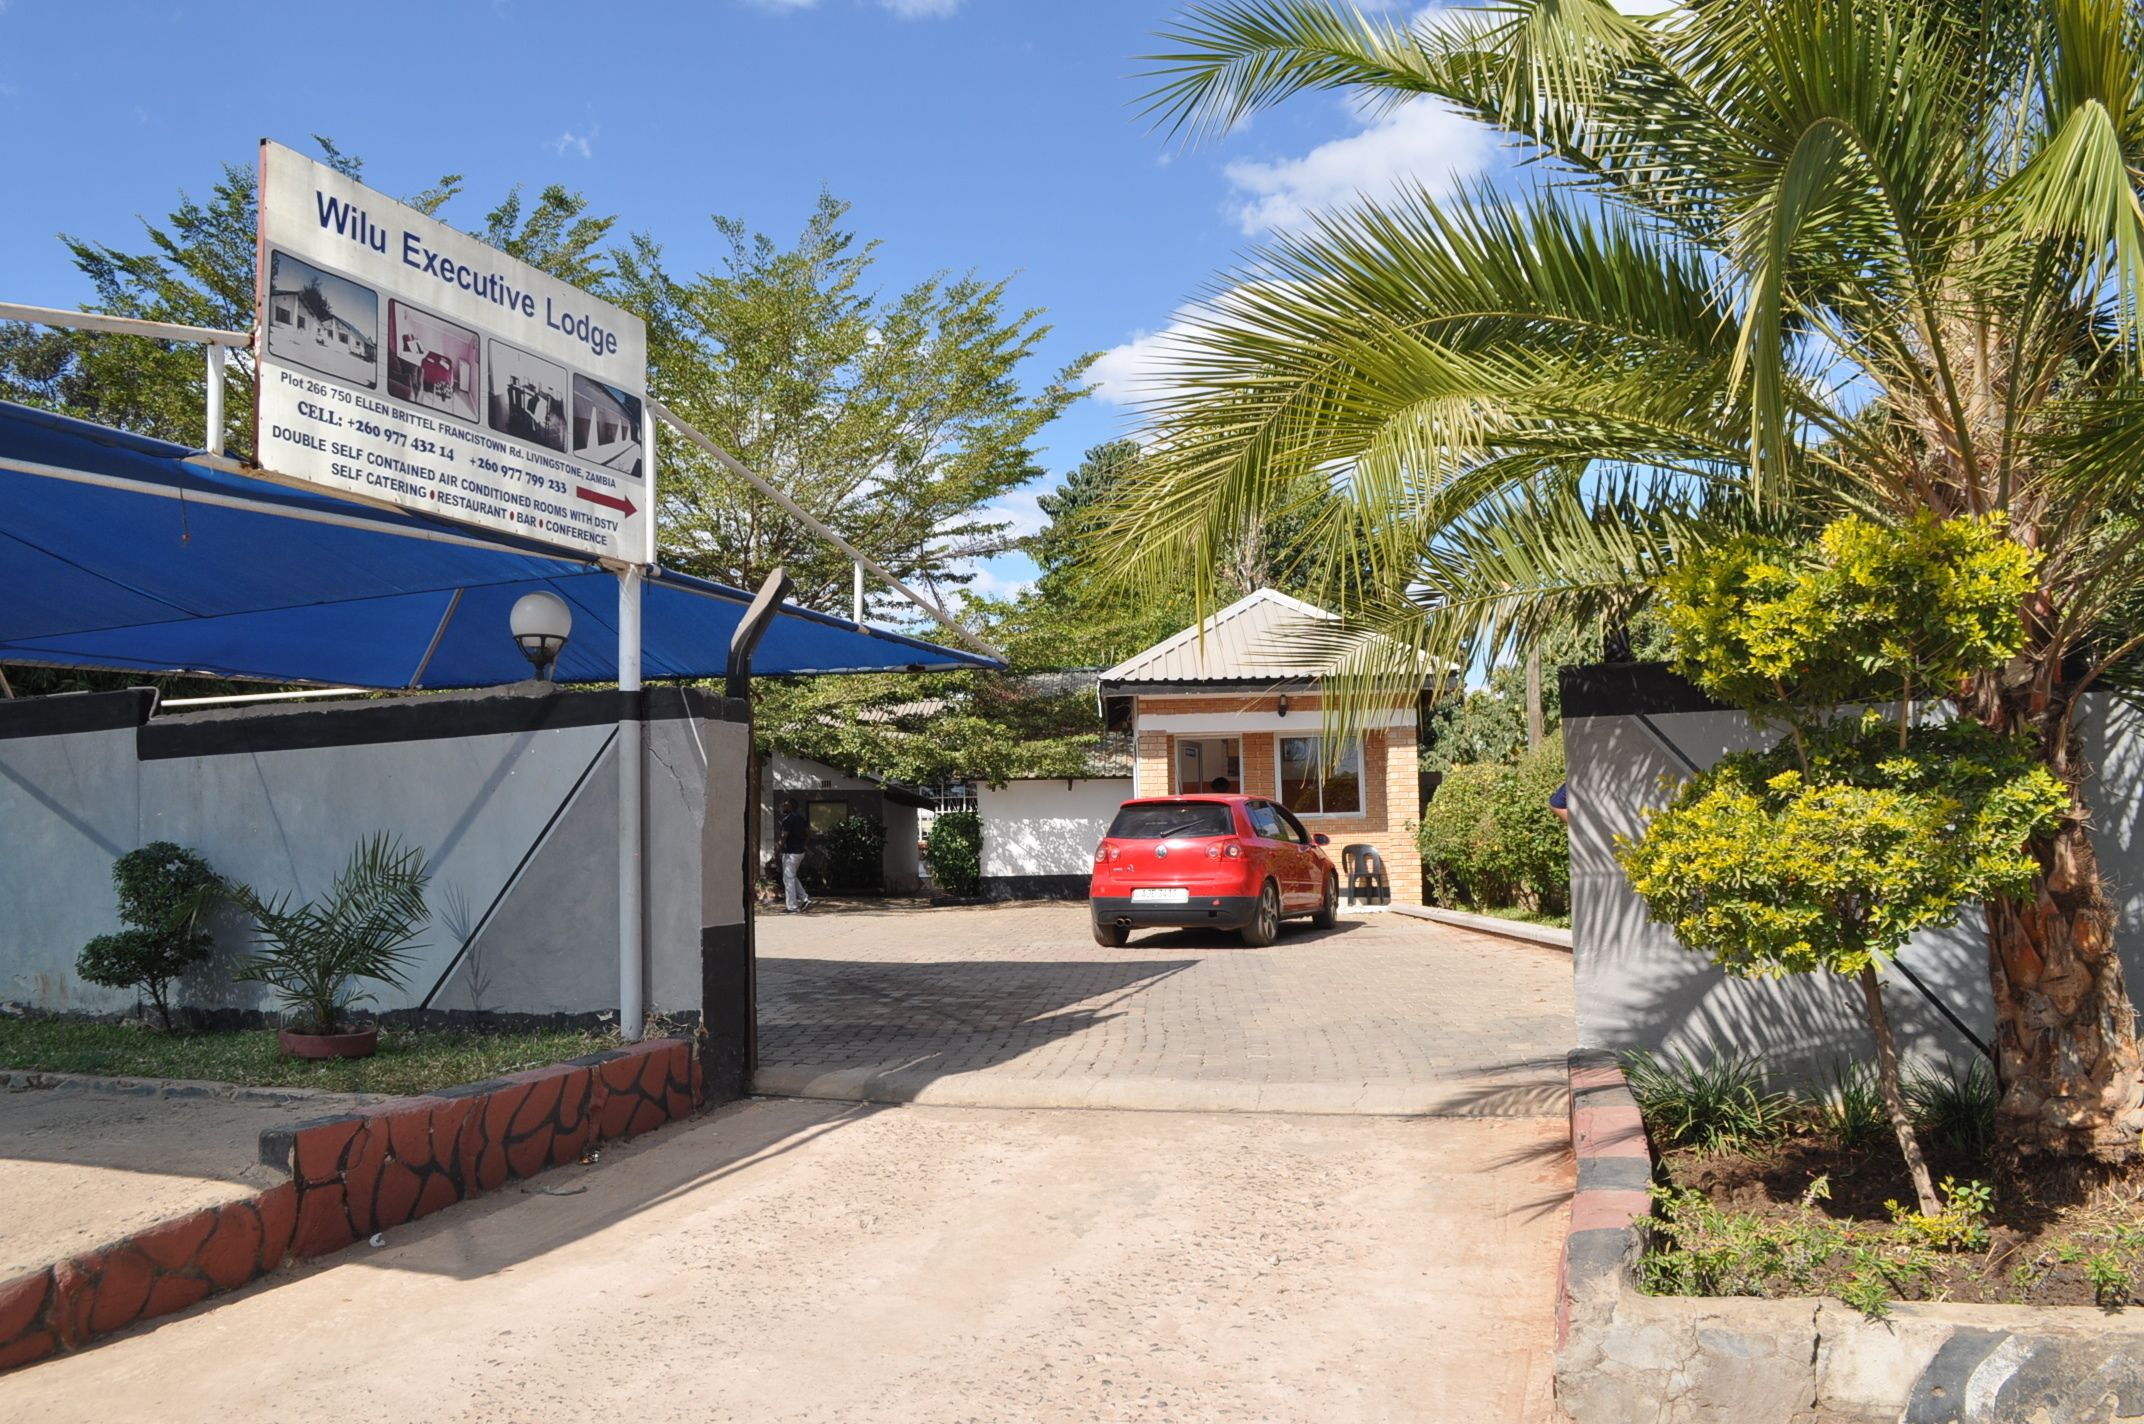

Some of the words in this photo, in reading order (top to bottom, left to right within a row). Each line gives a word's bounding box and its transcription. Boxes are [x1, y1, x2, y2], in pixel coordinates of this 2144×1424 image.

[316, 190, 386, 254] Wilu
[403, 231, 534, 318] Executive
[547, 297, 617, 356] Lodge
[272, 425, 327, 452] DOUBLE
[331, 442, 363, 460] SELF
[367, 452, 435, 481] CONTAINED
[439, 472, 457, 488] AIR
[461, 478, 531, 508] CONDITIONED
[533, 499, 568, 519] ROOMS
[570, 509, 593, 525] WITH
[594, 516, 618, 532] DSTV
[281, 371, 304, 389] Plot
[307, 380, 327, 397] 266
[330, 388, 352, 403] 750
[355, 395, 389, 416] ELLEN
[392, 408, 436, 431] BRITTEL
[438, 423, 507, 454] FRANCISTOWN
[509, 446, 524, 459] Rd.
[526, 451, 584, 480] LIVINGSTONE,
[585, 471, 616, 488] ZAMBIA
[297, 400, 342, 427] CELL:
[347, 418, 381, 437] +260
[384, 428, 407, 447] 977
[410, 437, 436, 454] 432
[439, 446, 455, 461] 14
[469, 457, 498, 473] +260
[501, 465, 522, 481] 977
[525, 471, 545, 488] 799
[548, 479, 567, 494] 233
[331, 462, 363, 481] SELF
[366, 472, 427, 498] CATERING
[437, 491, 507, 519] RESTAURANT
[516, 511, 536, 528] BAR
[545, 520, 607, 546] CONFERENCE
